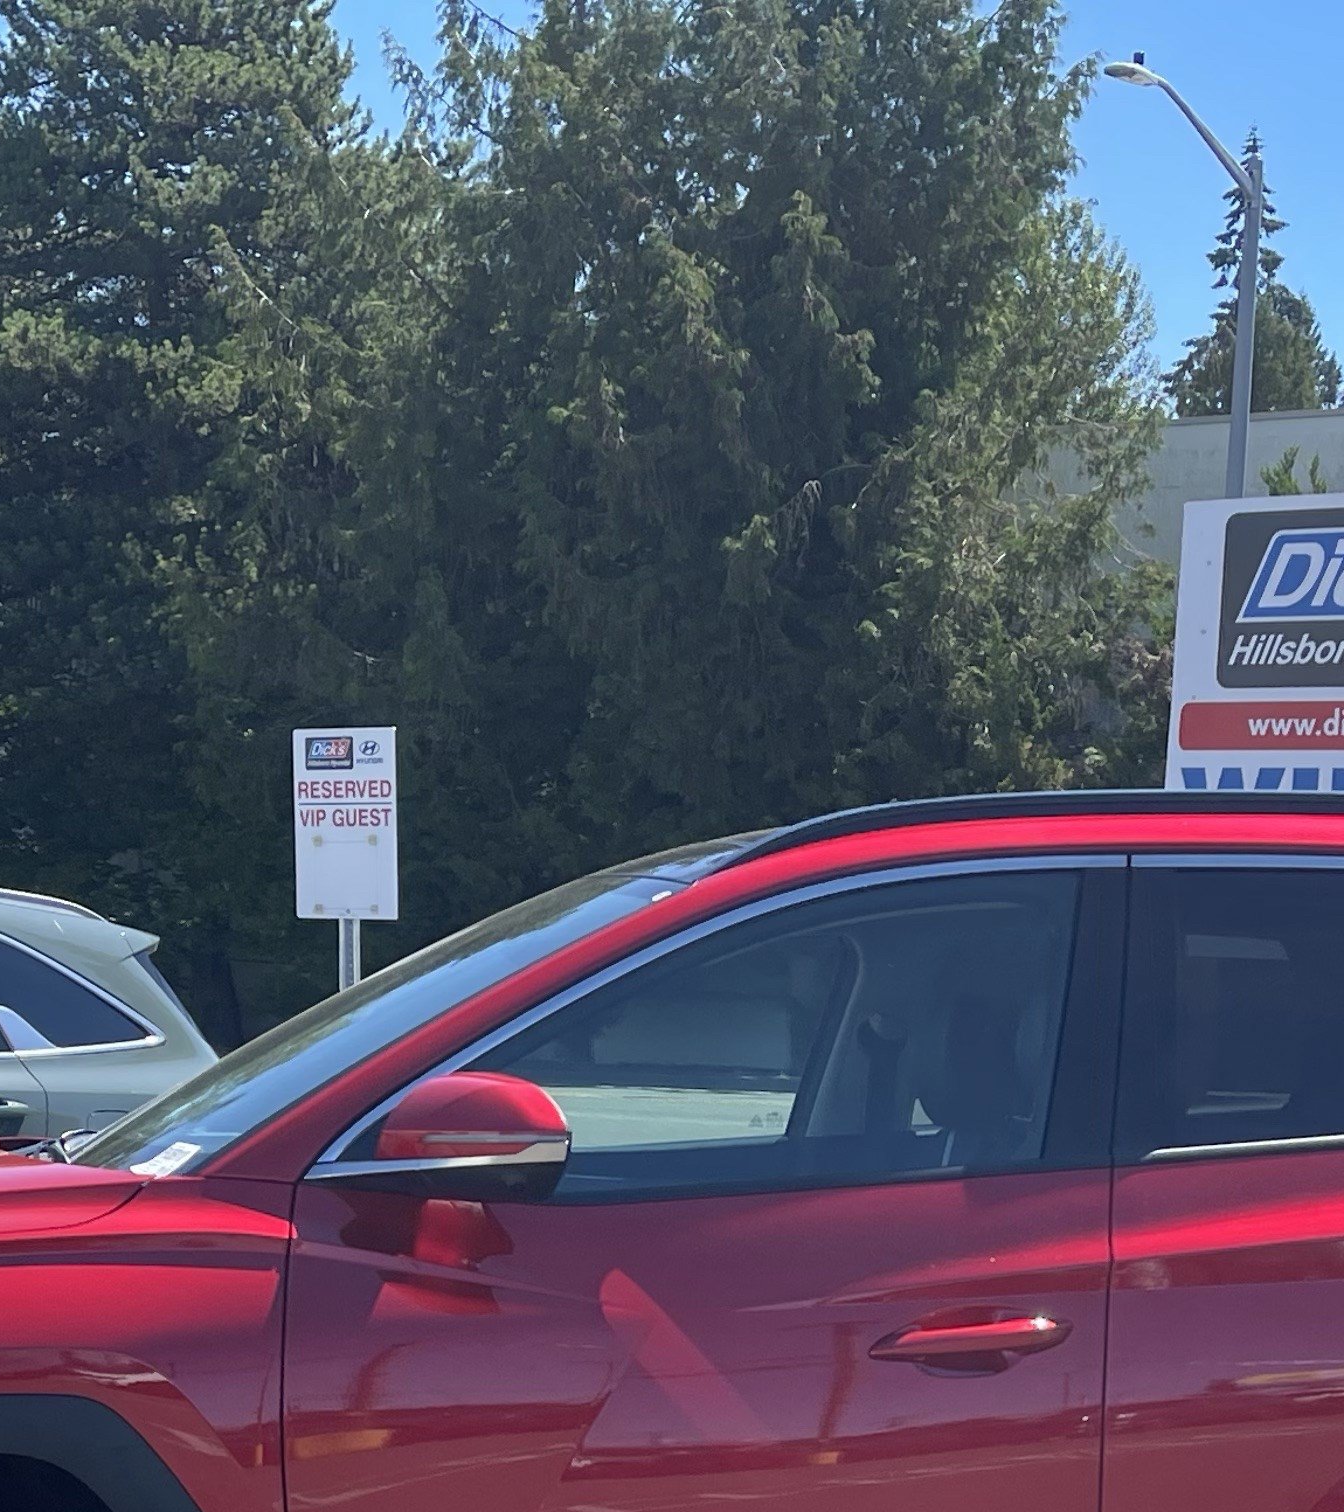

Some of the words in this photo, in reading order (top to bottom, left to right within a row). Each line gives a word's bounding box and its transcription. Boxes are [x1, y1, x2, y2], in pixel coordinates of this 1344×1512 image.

[298, 780, 392, 799] RESERVED
[299, 810, 326, 827] VIP
[332, 808, 392, 827] GUEST
